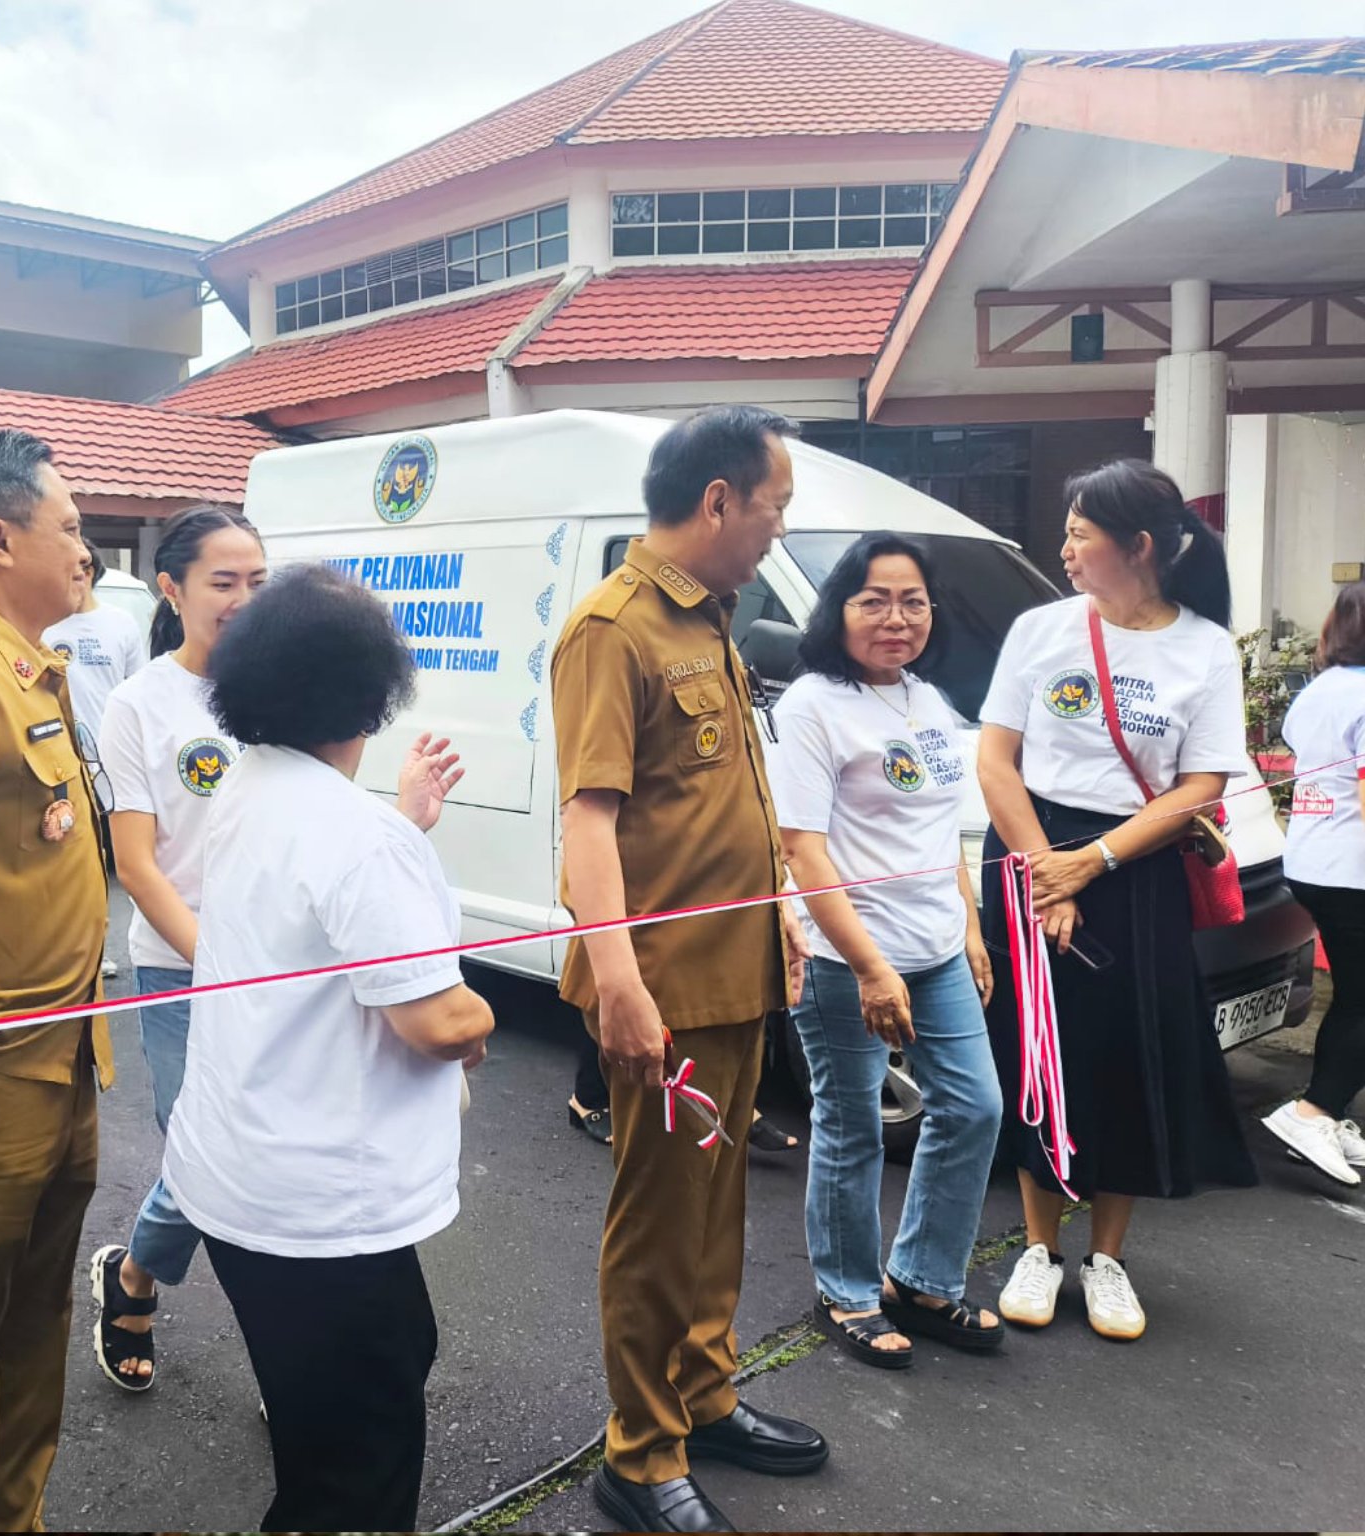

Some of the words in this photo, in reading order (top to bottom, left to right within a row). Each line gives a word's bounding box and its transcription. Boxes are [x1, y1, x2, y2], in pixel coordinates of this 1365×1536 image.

[361, 553, 464, 591] PELAYANAN
[391, 600, 484, 639] NASIONAL
[445, 649, 499, 672] TENGAH
[1111, 675, 1154, 692] MITRA
[1115, 697, 1133, 709] IZI
[915, 728, 944, 742] MITRA
[1101, 716, 1166, 738] TMOHON
[1217, 1007, 1227, 1035] B
